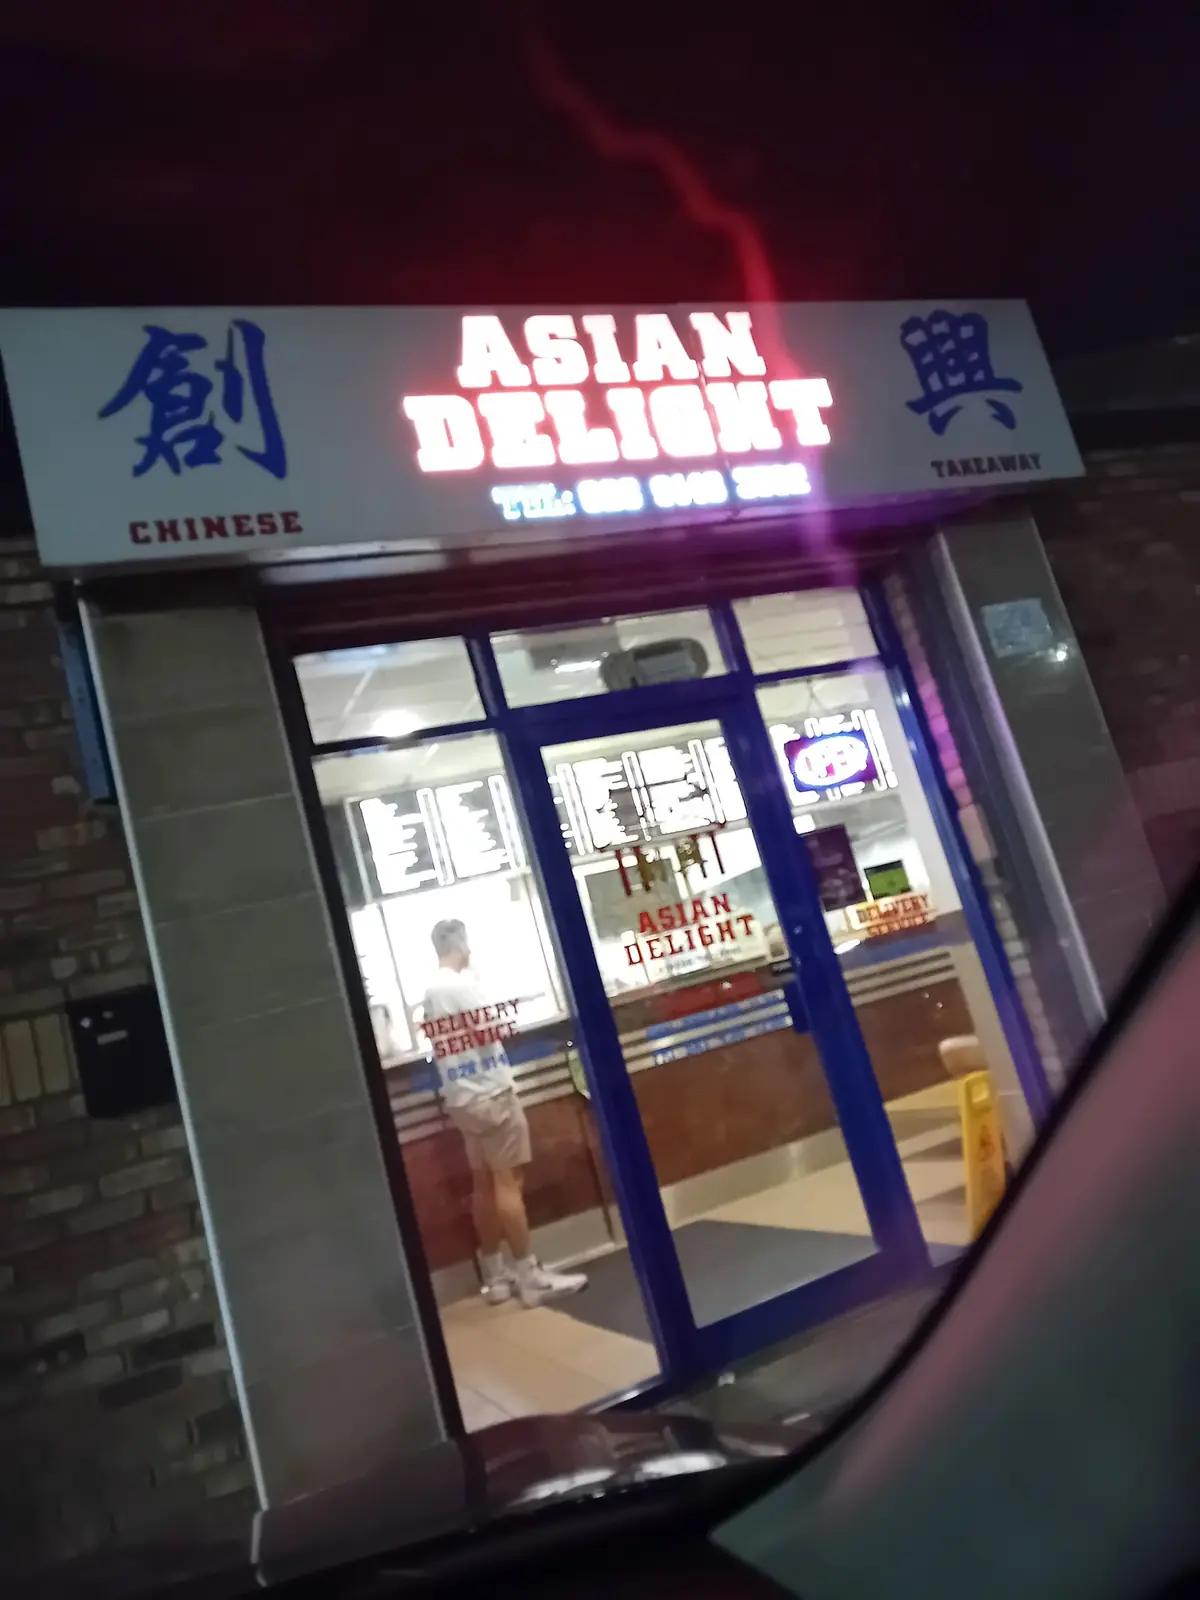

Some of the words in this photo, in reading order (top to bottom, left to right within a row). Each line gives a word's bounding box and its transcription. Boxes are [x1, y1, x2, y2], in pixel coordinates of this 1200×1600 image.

[457, 311, 767, 388] ASIAN
[900, 309, 1024, 436] 興
[98, 318, 288, 479] 創
[403, 378, 834, 473] DELIGHT
[930, 453, 1042, 478] TAKEAWAY
[129, 510, 304, 545] CHINESE
[638, 892, 732, 935] ASIAN
[623, 913, 754, 966] DELIGHT
[421, 998, 520, 1039] DELIVERY
[434, 1021, 521, 1061] SERVICE
